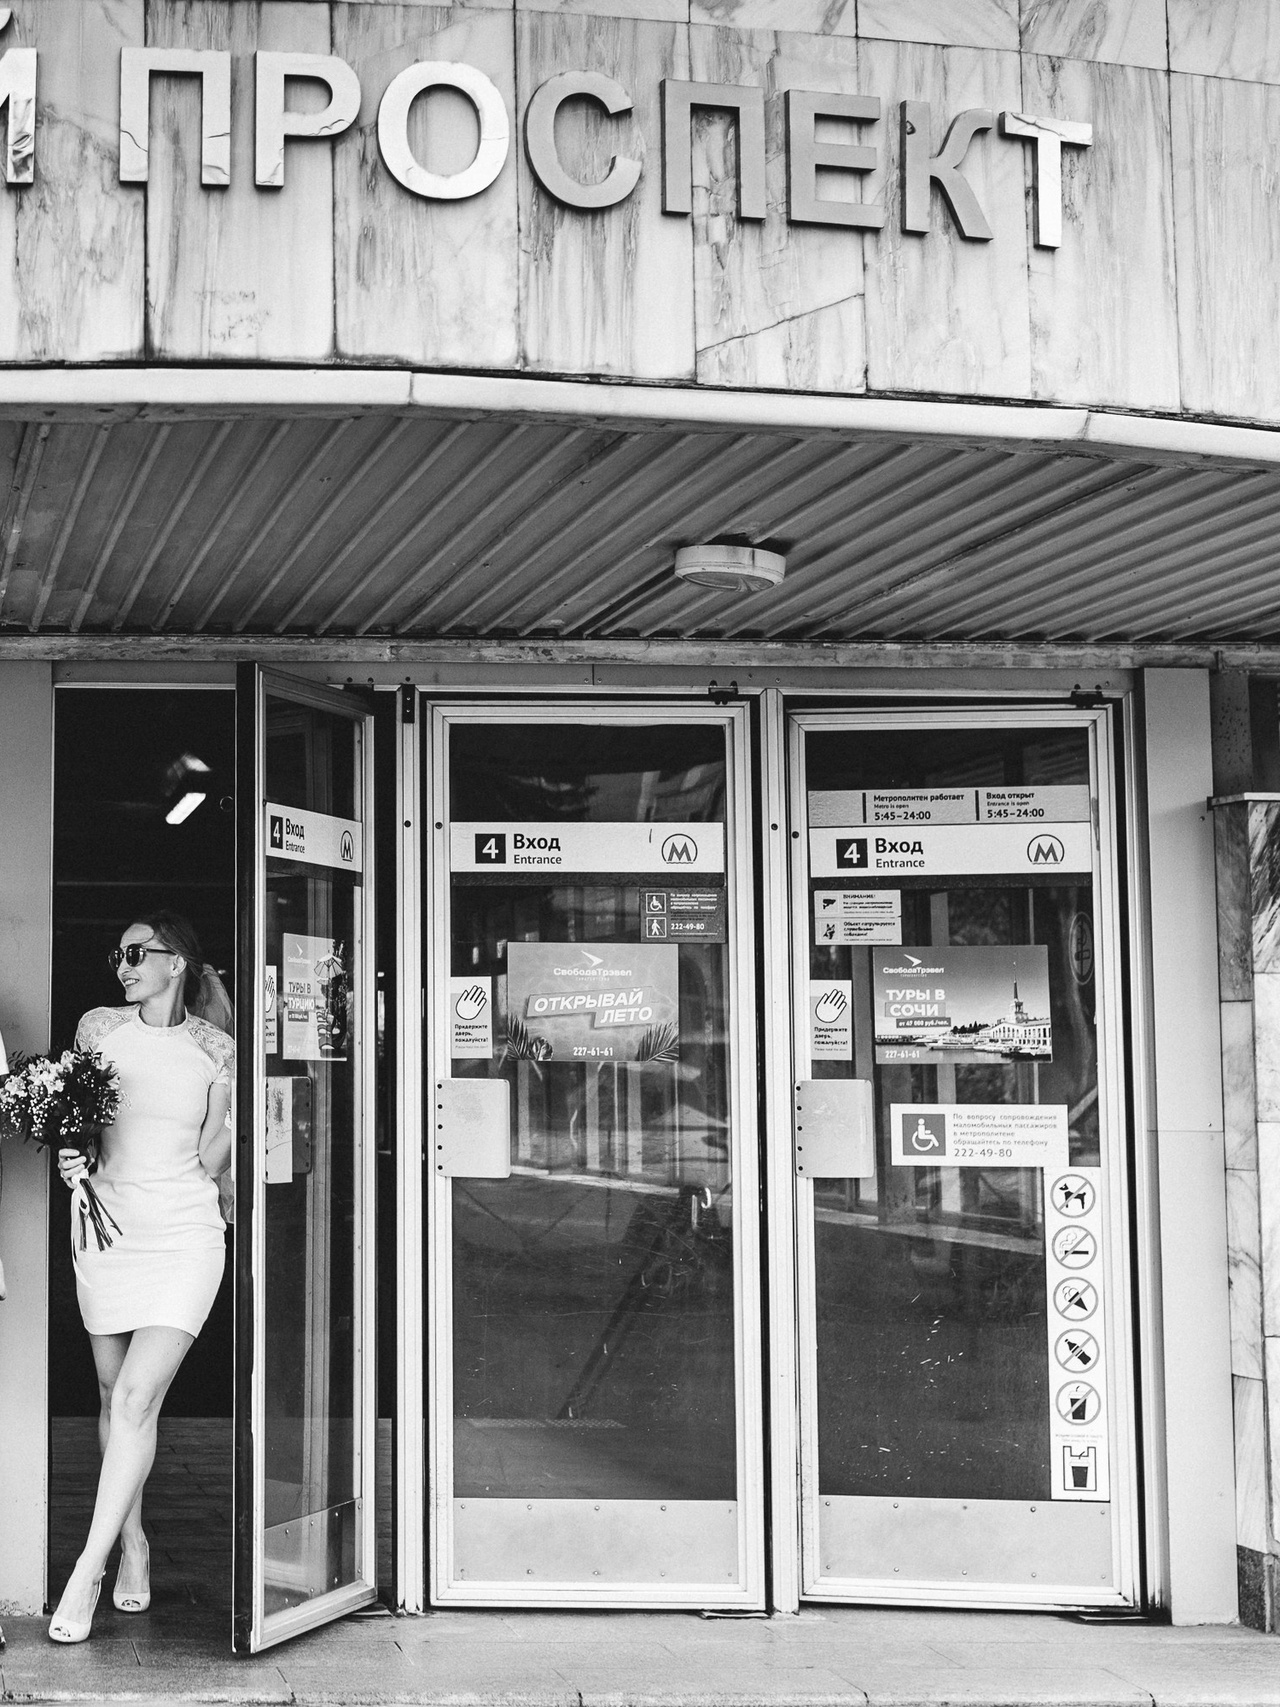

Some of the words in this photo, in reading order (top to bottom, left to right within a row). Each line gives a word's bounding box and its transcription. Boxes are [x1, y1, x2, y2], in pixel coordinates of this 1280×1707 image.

[119, 46, 1093, 250] ПРОСПЕКТ
[873, 795, 928, 803] Метрополитен
[930, 793, 964, 802] работает
[986, 792, 1006, 800] Вход
[1007, 792, 1035, 800] открыт
[273, 821, 281, 844] 4
[285, 818, 305, 840] Вход
[285, 840, 305, 853] Entrance
[482, 837, 499, 859] 4
[513, 833, 561, 851] Вход
[875, 838, 924, 855] Вход
[513, 854, 562, 864] Entrance
[843, 842, 860, 864] 4
[876, 859, 925, 868] Entrance
[553, 967, 632, 976] СвободаТрэвел
[288, 982, 305, 994] ТУРЫ
[307, 983, 312, 994] В
[534, 988, 644, 1012] ОТКРЫВАЙ
[886, 989, 930, 1000] ТУРЫ
[934, 989, 946, 1000] В
[600, 1007, 653, 1024] ЛЕТО
[889, 1004, 939, 1016] СОЧИ
[573, 1047, 613, 1056] 227-61-61
[885, 1050, 920, 1058] 227-61-61
[954, 1148, 1012, 1157] 222-49-80
